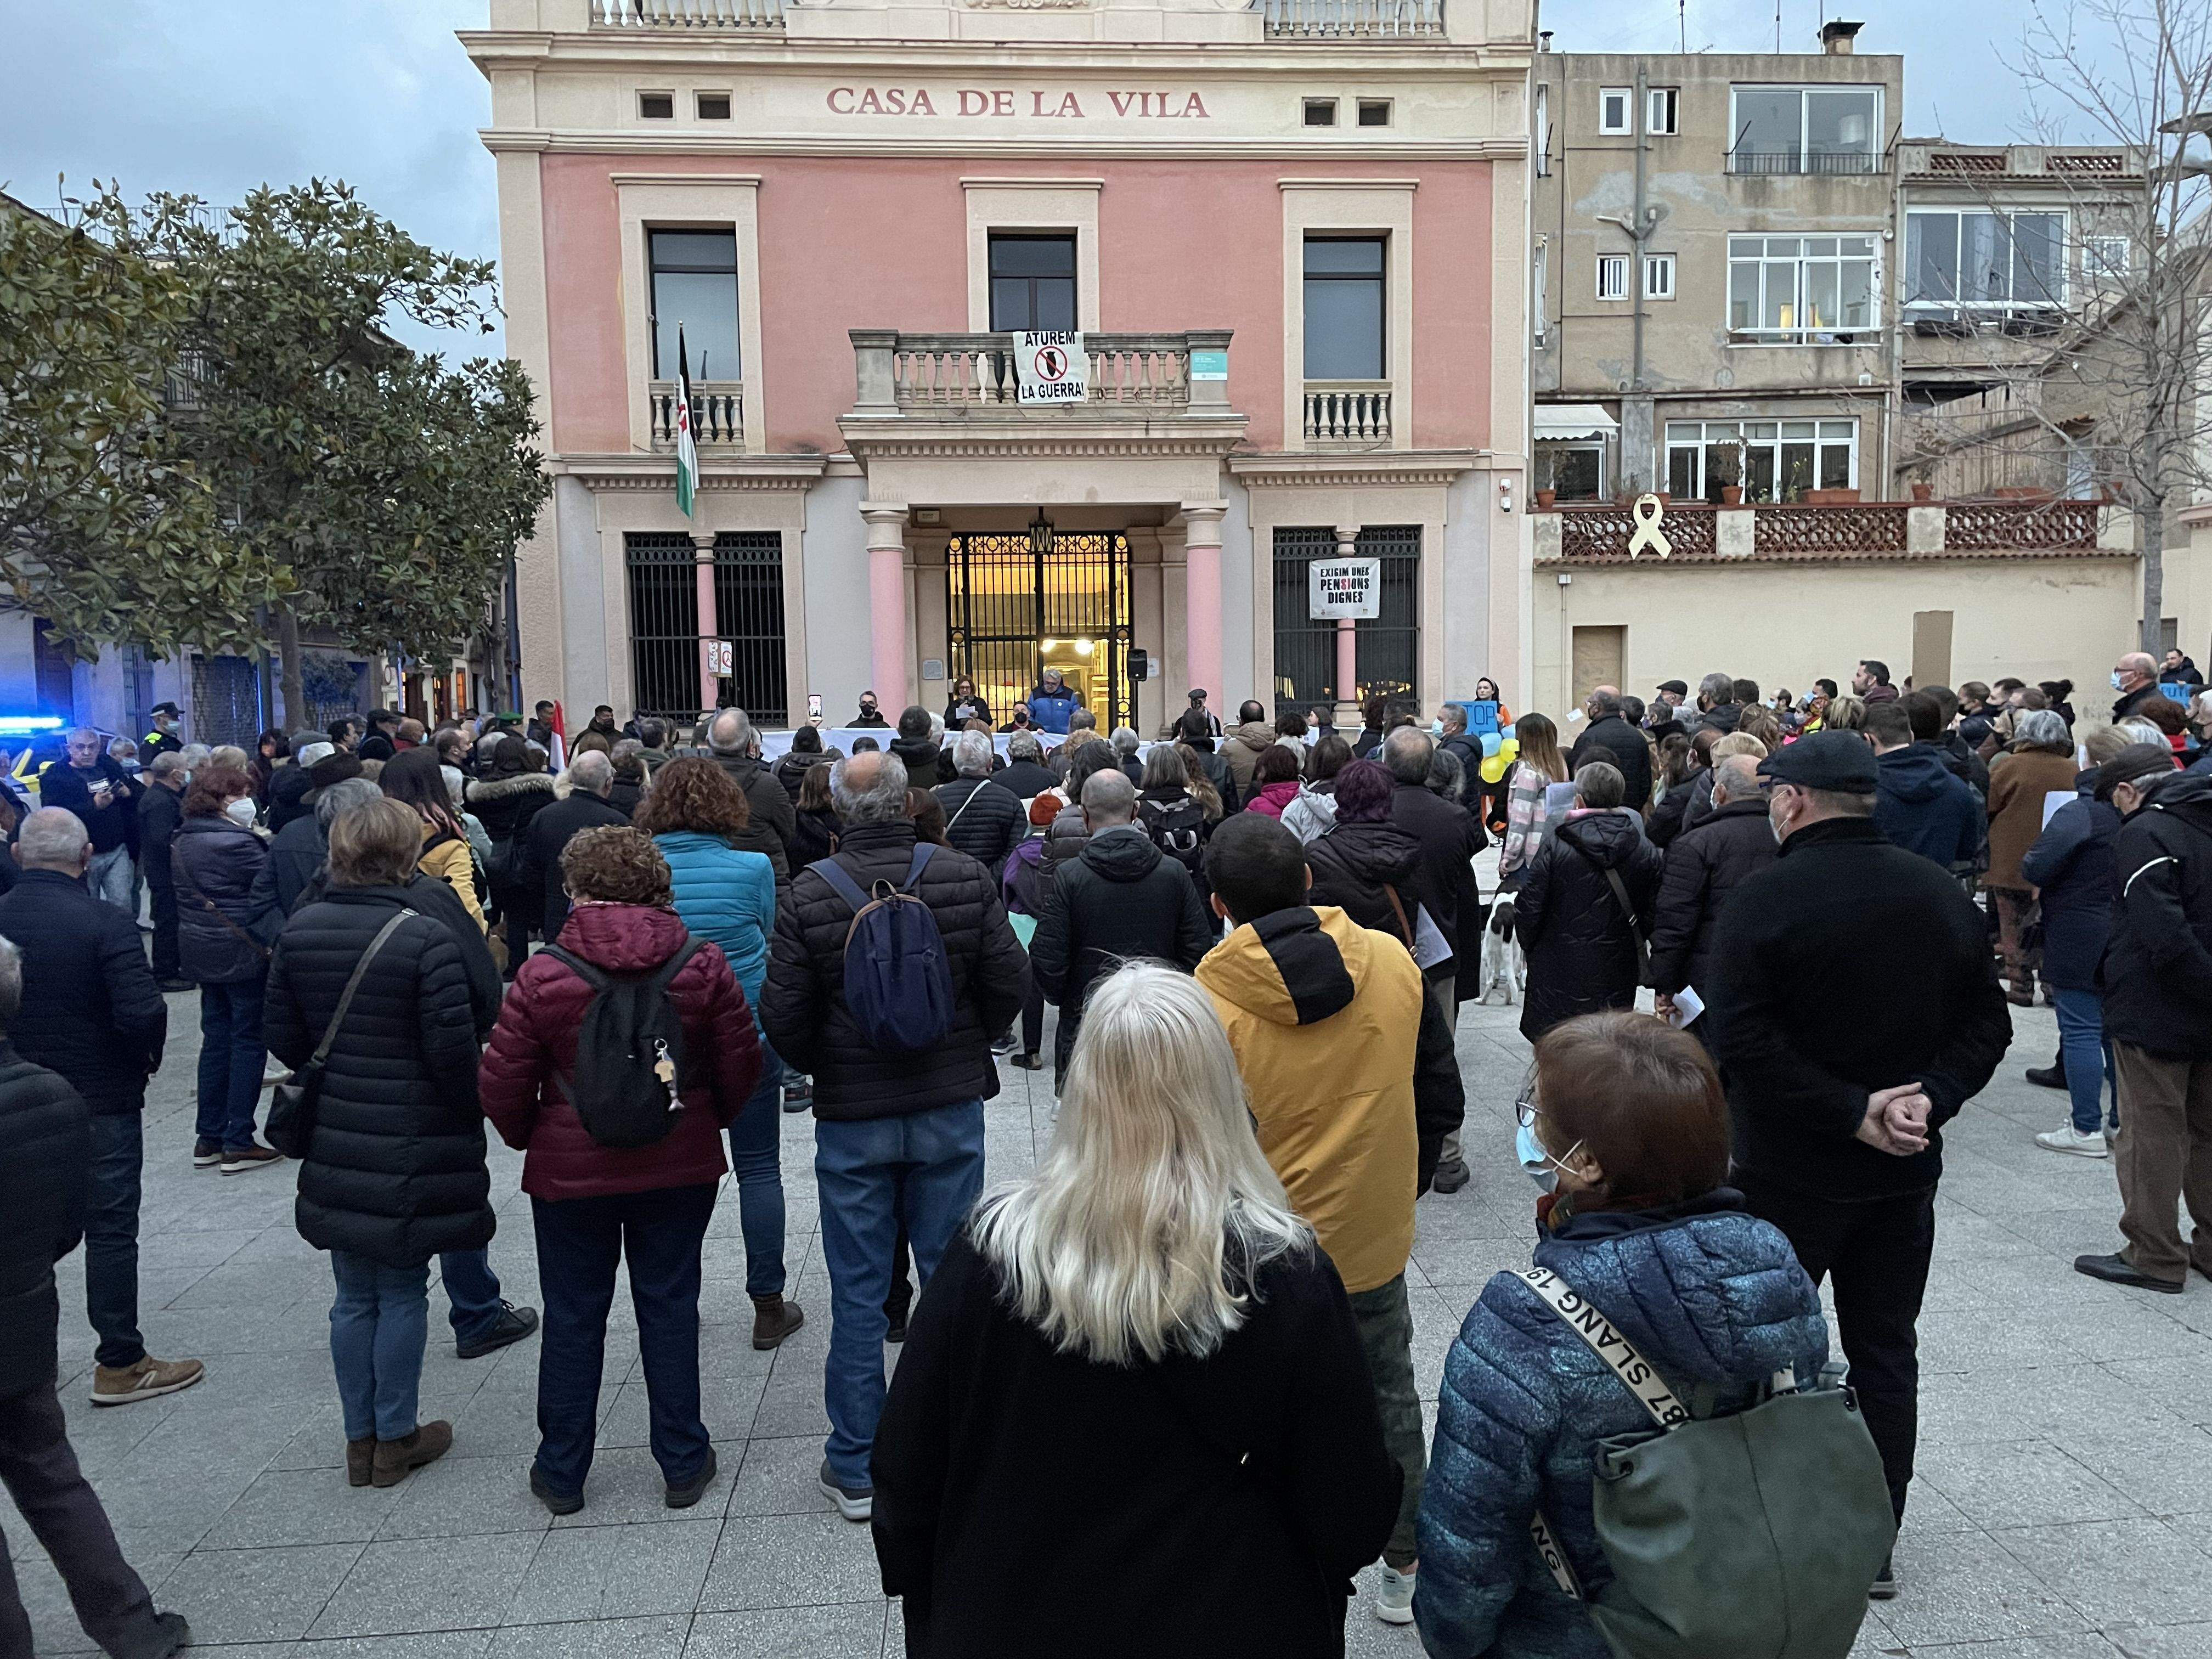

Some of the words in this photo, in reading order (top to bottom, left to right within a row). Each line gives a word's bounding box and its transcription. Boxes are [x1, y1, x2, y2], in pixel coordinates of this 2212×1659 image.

[826, 88, 938, 115] CASA
[957, 91, 1015, 117] DE
[1031, 91, 1085, 117] LA
[1107, 92, 1210, 118] VILA
[1025, 331, 1075, 346] ATUREM
[1022, 385, 1035, 399] LA
[1039, 383, 1084, 398] GUERRA!
[1321, 567, 1348, 577] EXIGIM
[1352, 567, 1369, 576] UNES
[1321, 578, 1369, 591] PENSIONS
[1328, 591, 1363, 603] DIGNES
[1462, 705, 1495, 725] TOP
[1517, 1268, 1556, 1289] 19
[1557, 1290, 1651, 1386] SLANG
